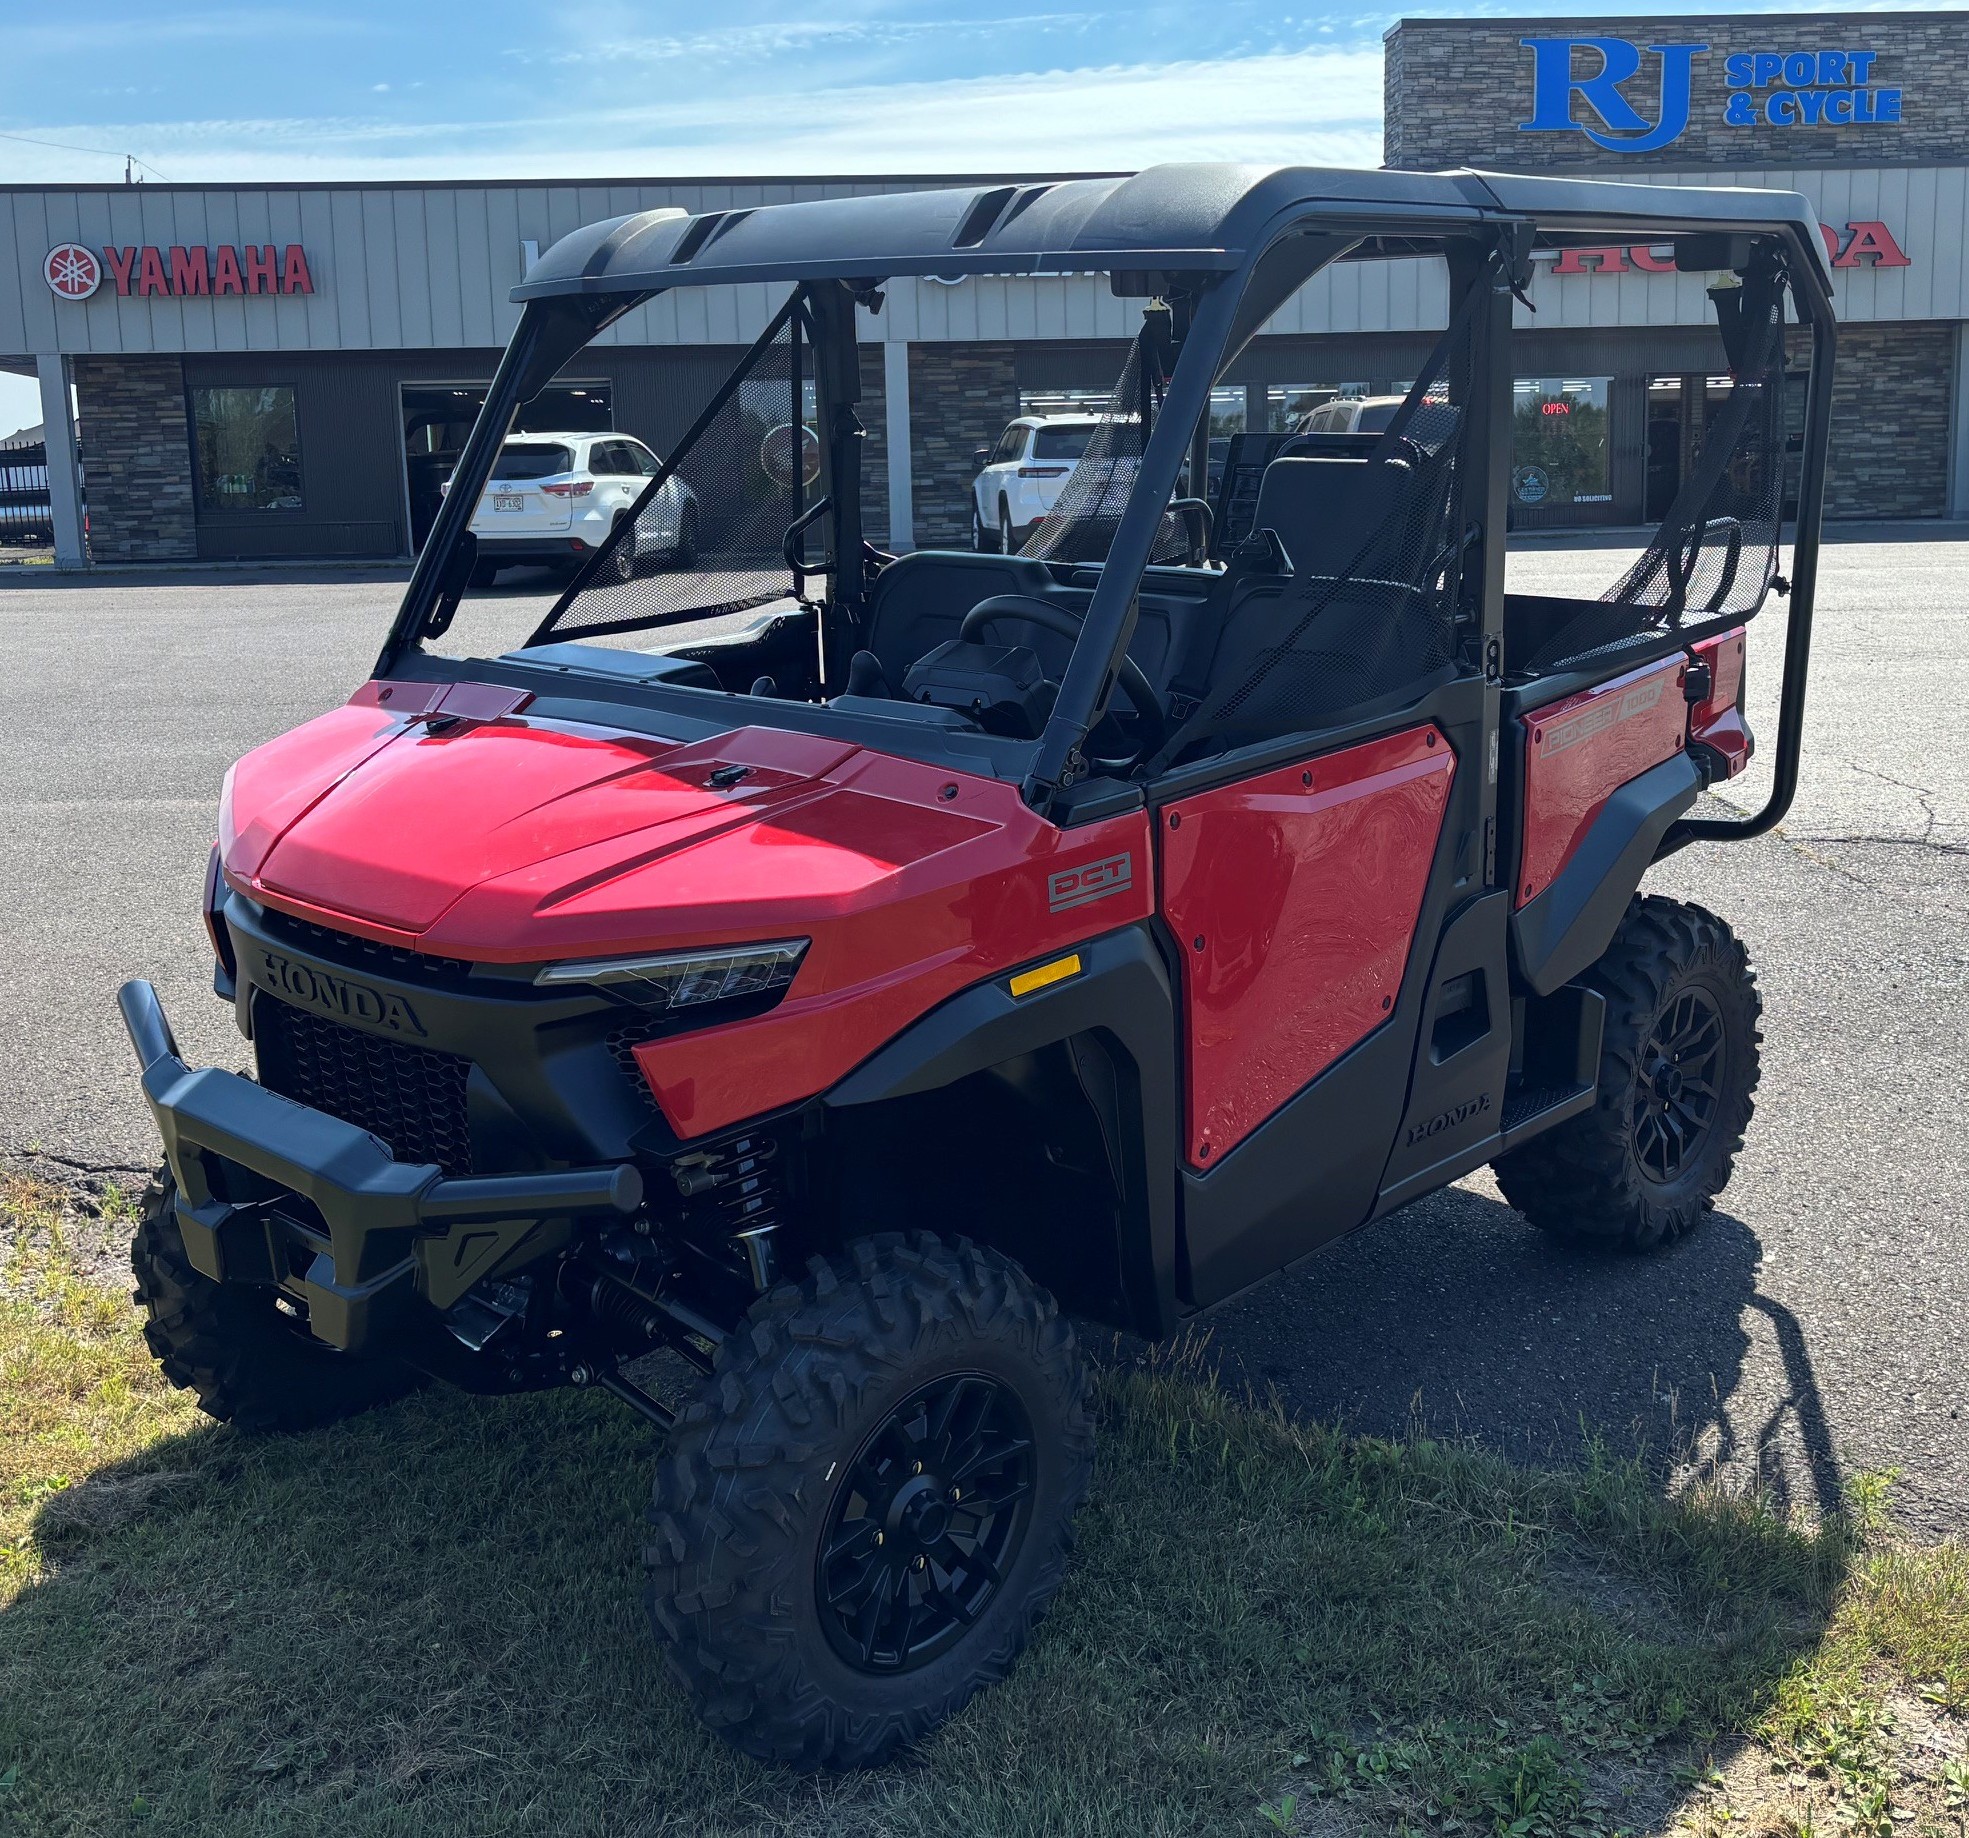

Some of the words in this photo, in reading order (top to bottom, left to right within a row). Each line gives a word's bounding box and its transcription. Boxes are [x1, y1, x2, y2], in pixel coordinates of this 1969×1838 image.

[1724, 50, 1876, 88] SPORT
[1518, 36, 1710, 152] RJ
[1722, 91, 1758, 126] &
[1764, 88, 1901, 125] CYCLE
[102, 244, 314, 296] YAMAHA
[1542, 403, 1569, 415] OPEN
[1548, 705, 1612, 750] PIONEER
[1055, 858, 1126, 895] DCT
[258, 949, 428, 1038] HONDA
[1406, 1092, 1491, 1147] HONDA
